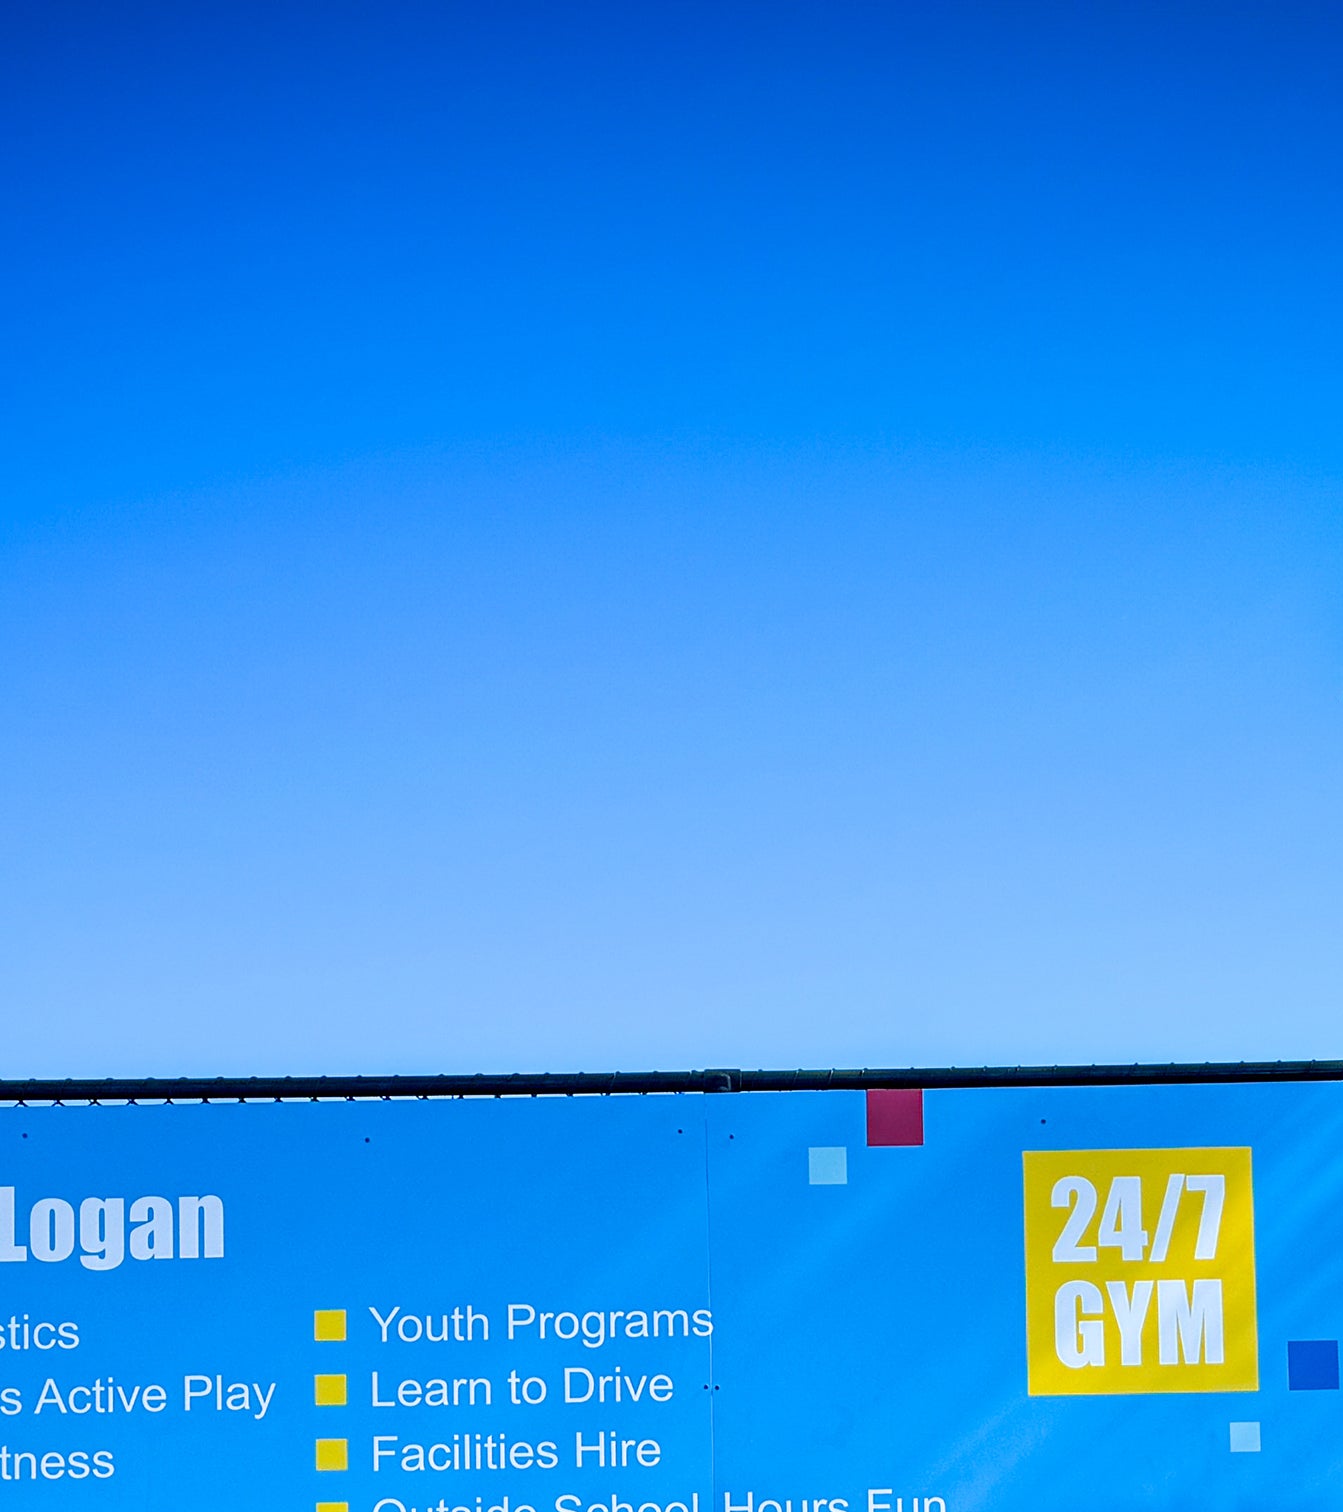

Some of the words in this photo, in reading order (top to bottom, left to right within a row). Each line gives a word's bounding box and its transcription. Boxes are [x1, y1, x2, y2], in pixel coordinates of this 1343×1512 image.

[1050, 1173, 1226, 1263] 24/7
[369, 1305, 489, 1342] Youth
[508, 1304, 714, 1348] Programs
[1054, 1278, 1225, 1369] GYM
[34, 1377, 167, 1414] Active
[184, 1375, 276, 1420] Play
[372, 1371, 491, 1407] Learn
[507, 1370, 547, 1405] to
[564, 1366, 673, 1403] Drive
[373, 1433, 558, 1472] Facilities
[576, 1431, 661, 1468] Hire
